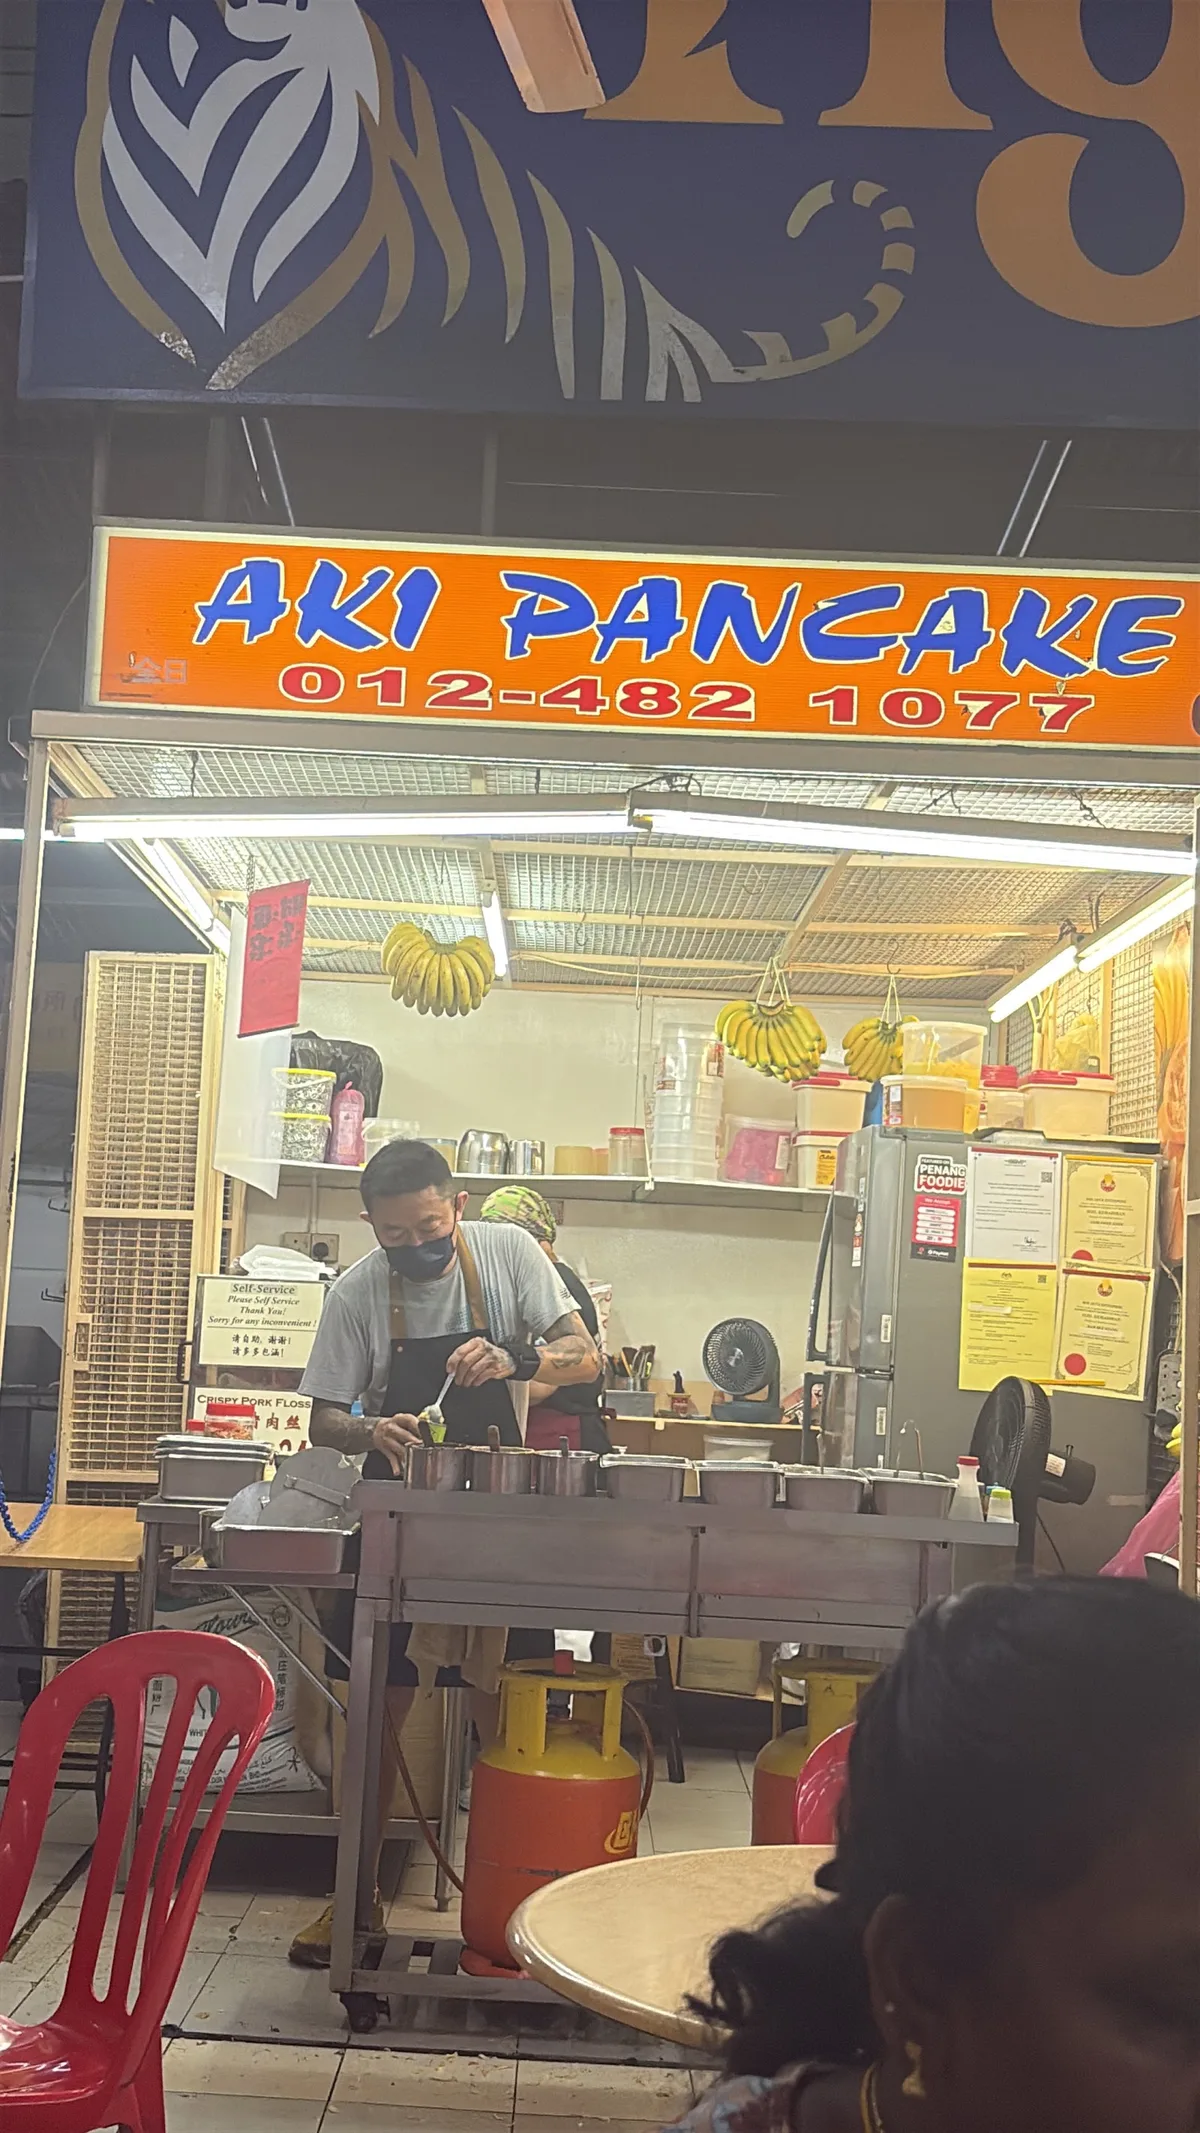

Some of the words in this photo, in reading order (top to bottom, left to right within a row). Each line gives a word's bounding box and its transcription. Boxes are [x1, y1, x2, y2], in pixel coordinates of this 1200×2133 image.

[193, 557, 442, 652] AKI
[500, 571, 1185, 679] PANCAKE
[277, 662, 756, 721] 012-482
[810, 685, 1096, 733] 1077
[920, 1164, 966, 1176] PENANG
[919, 1175, 966, 1188] FOODIE
[232, 1283, 296, 1295] Self-Service
[227, 1295, 253, 1304] Please
[253, 1296, 271, 1306] Self
[271, 1297, 300, 1305] Service
[240, 1306, 265, 1315] Thank
[267, 1308, 287, 1316] You!
[208, 1316, 230, 1326] Sorry
[231, 1317, 244, 1326] for
[245, 1319, 260, 1327] any
[261, 1319, 311, 1327] inconvenient
[197, 1394, 238, 1404] CRISPY
[241, 1396, 272, 1407] PORK
[275, 1398, 311, 1409] FLOSS
